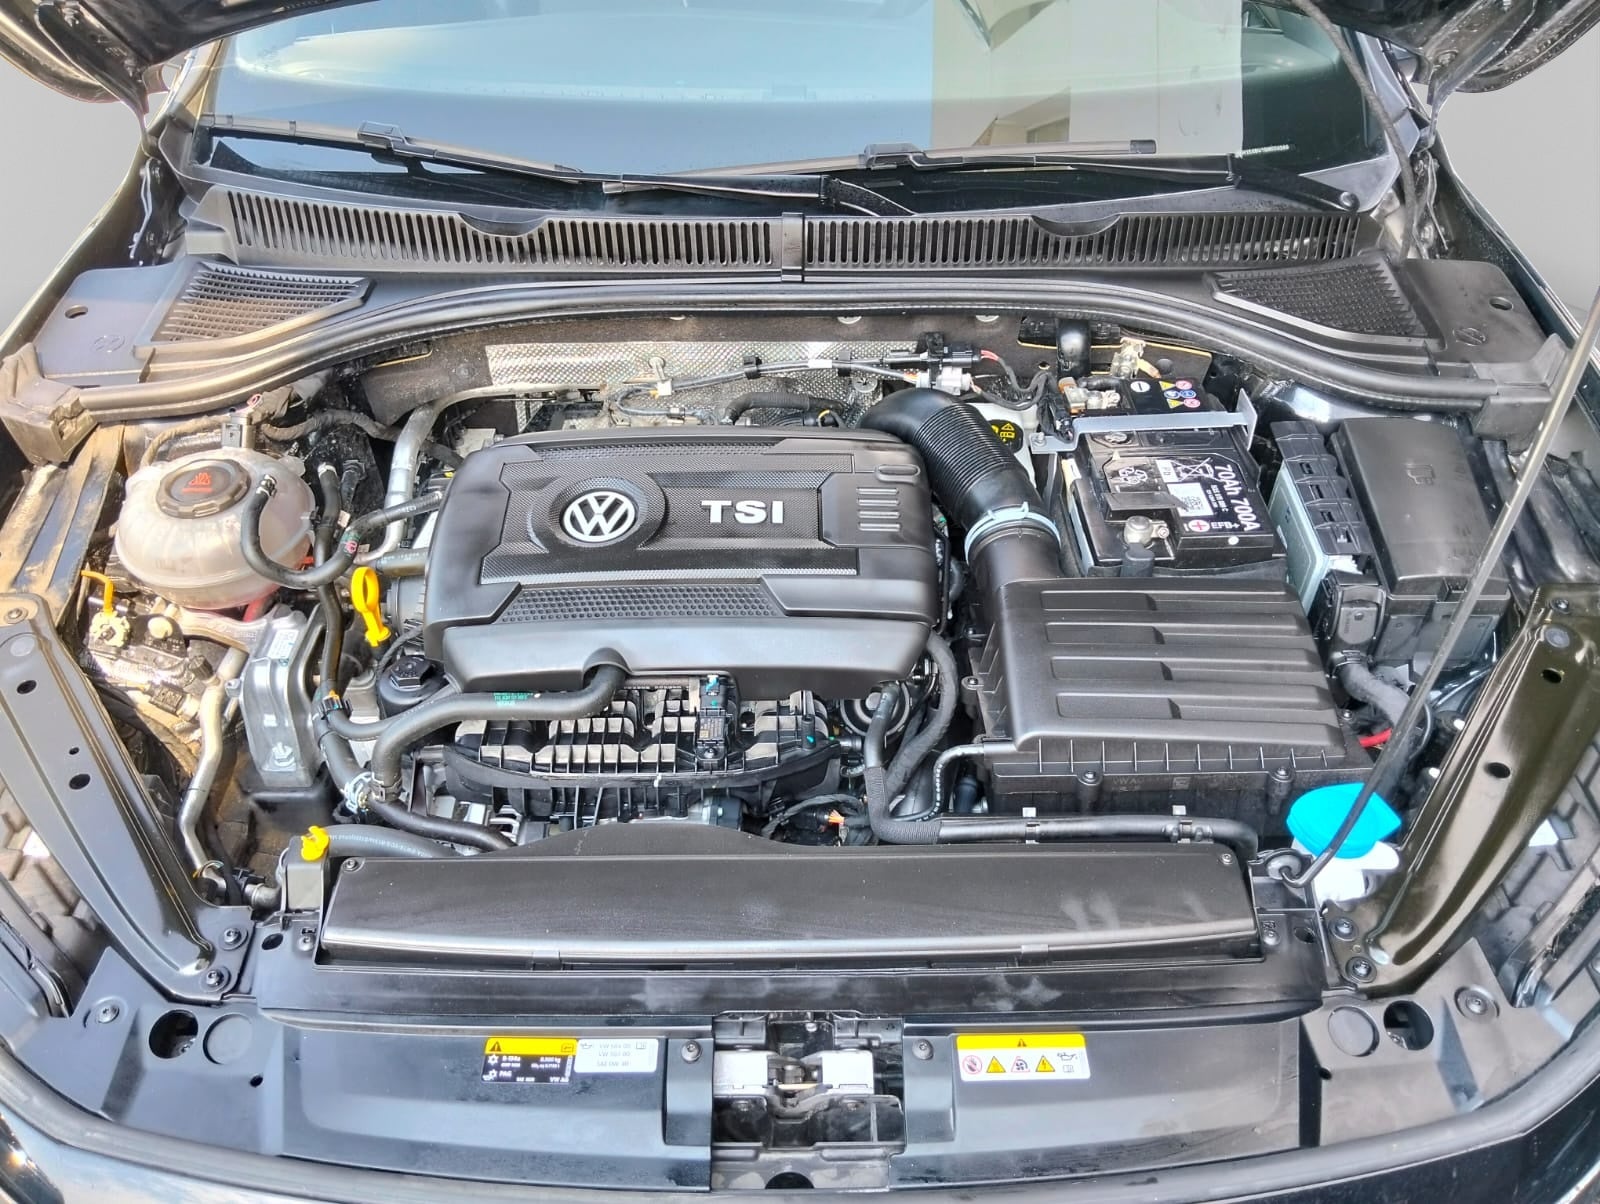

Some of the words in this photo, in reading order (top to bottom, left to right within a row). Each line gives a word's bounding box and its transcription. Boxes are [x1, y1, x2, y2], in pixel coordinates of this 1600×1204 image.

[563, 490, 636, 543] VW
[701, 500, 784, 524] TSI
[1214, 464, 1242, 495] 70Ah
[1230, 497, 1261, 531] 700A
